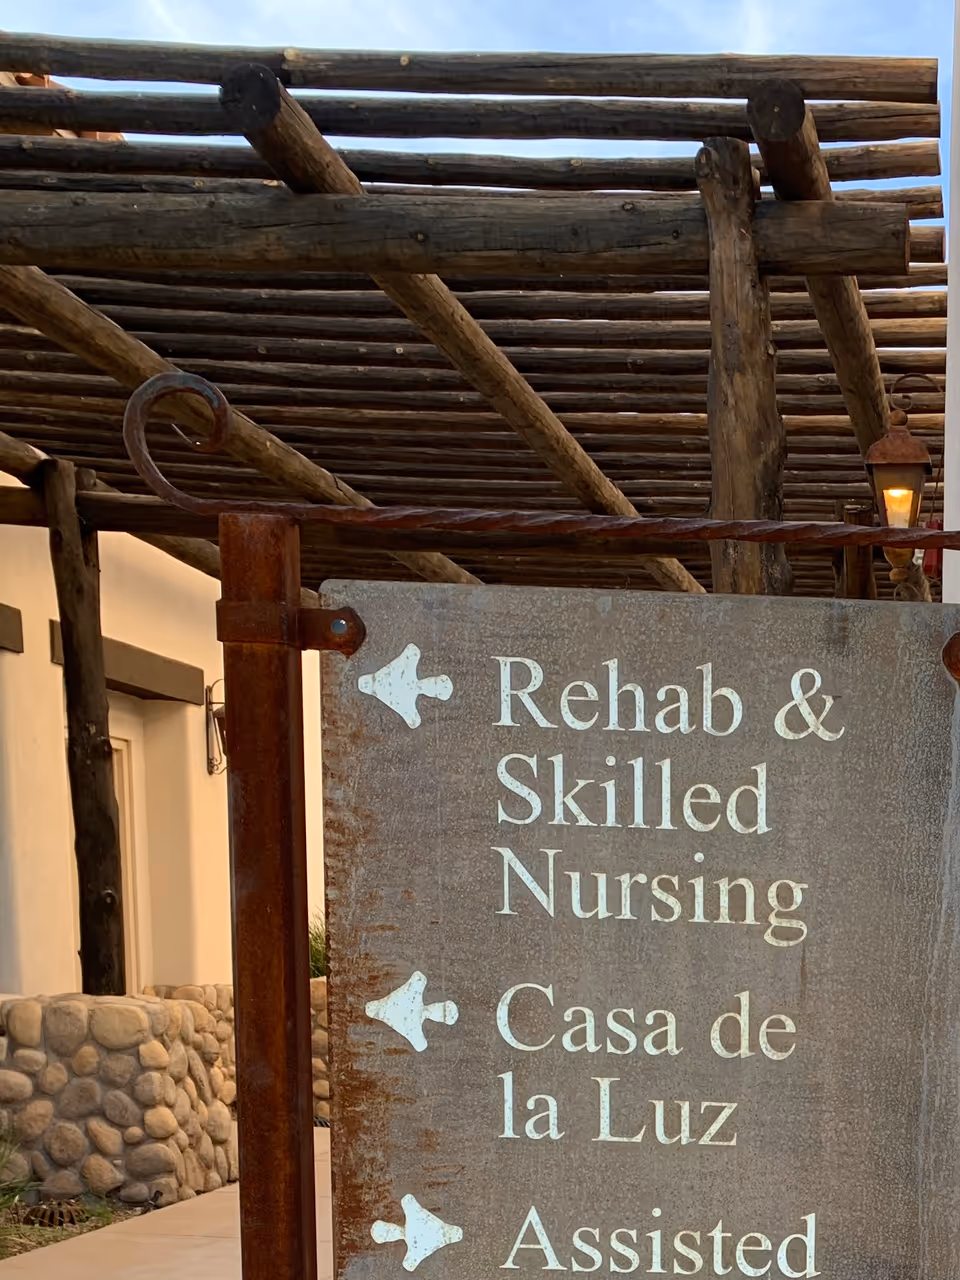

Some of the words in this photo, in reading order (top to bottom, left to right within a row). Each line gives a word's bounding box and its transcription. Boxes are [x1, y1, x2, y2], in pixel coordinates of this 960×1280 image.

[491, 655, 743, 737] Rehab
[773, 667, 845, 742] &
[496, 753, 773, 835] Skilled
[490, 846, 809, 947] Nursing
[496, 983, 684, 1056] Casa
[710, 990, 797, 1061] de
[497, 1071, 566, 1140] la
[590, 1076, 738, 1146] Luz
[499, 1205, 822, 1279] Assisted
